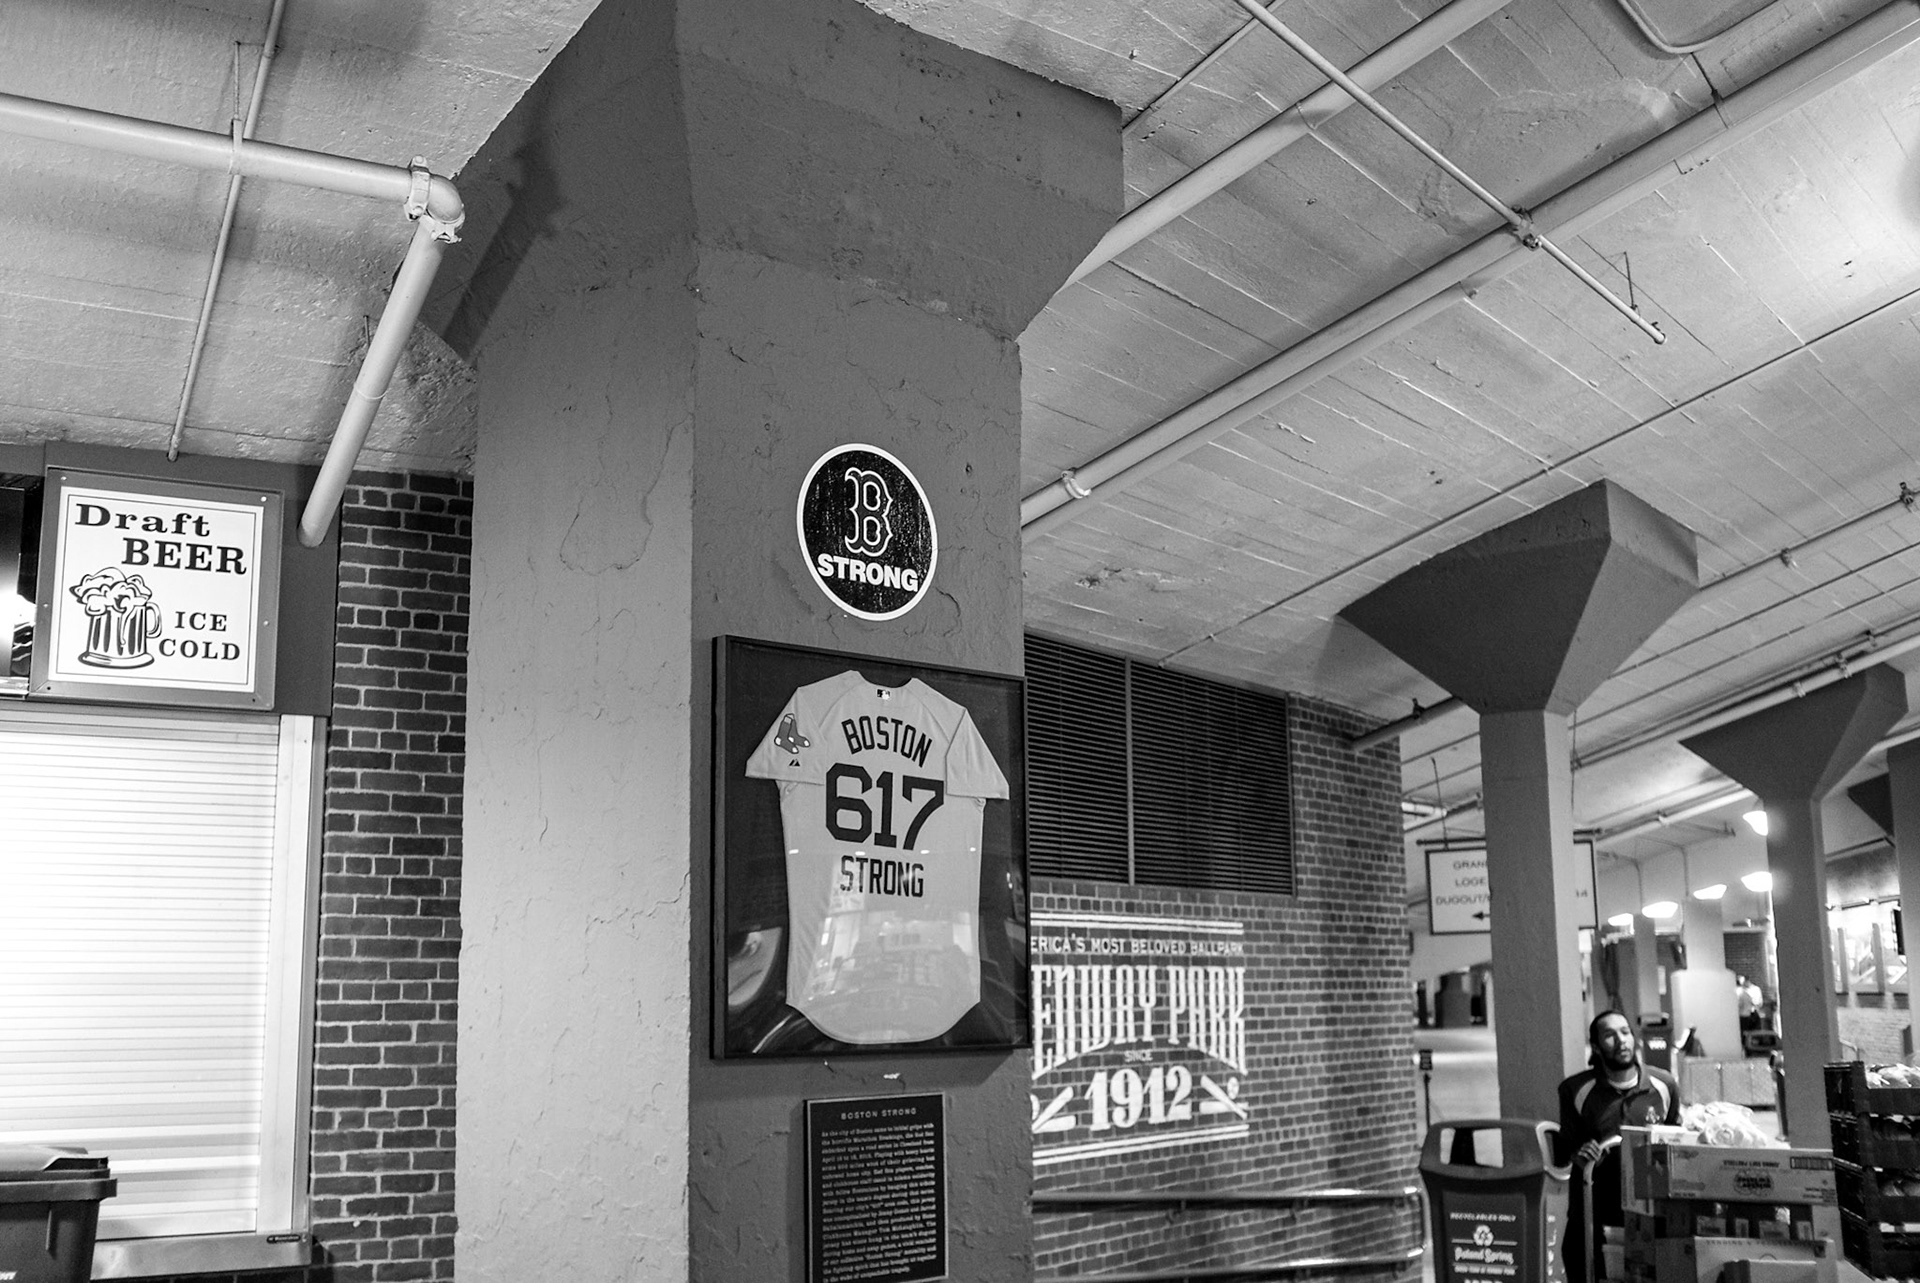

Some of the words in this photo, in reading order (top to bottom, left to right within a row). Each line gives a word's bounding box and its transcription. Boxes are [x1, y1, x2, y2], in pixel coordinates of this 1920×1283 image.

[74, 502, 211, 537] Draft
[844, 466, 893, 557] B
[121, 536, 247, 575] BEER
[817, 553, 919, 593] STRONG
[174, 611, 228, 632] ICE
[158, 638, 241, 661] COLD
[840, 714, 933, 768] BOSTON
[825, 762, 944, 851] 617
[839, 855, 924, 898] STRONG
[1453, 860, 1487, 871] GRAN
[1090, 937, 1125, 954] MOST
[1131, 937, 1186, 955] BELOVED
[1190, 940, 1244, 956] BALLPARK
[1166, 965, 1249, 1076] PARK
[1124, 1049, 1153, 1063] SINCE
[841, 1110, 878, 1121] BOSTON
[881, 1107, 917, 1118] STRONG
[1083, 1065, 1193, 1132] 1912
[1450, 1212, 1498, 1222] RECYCLABLES
[1454, 1246, 1485, 1261] Poland
[1484, 1248, 1514, 1265] Spring
